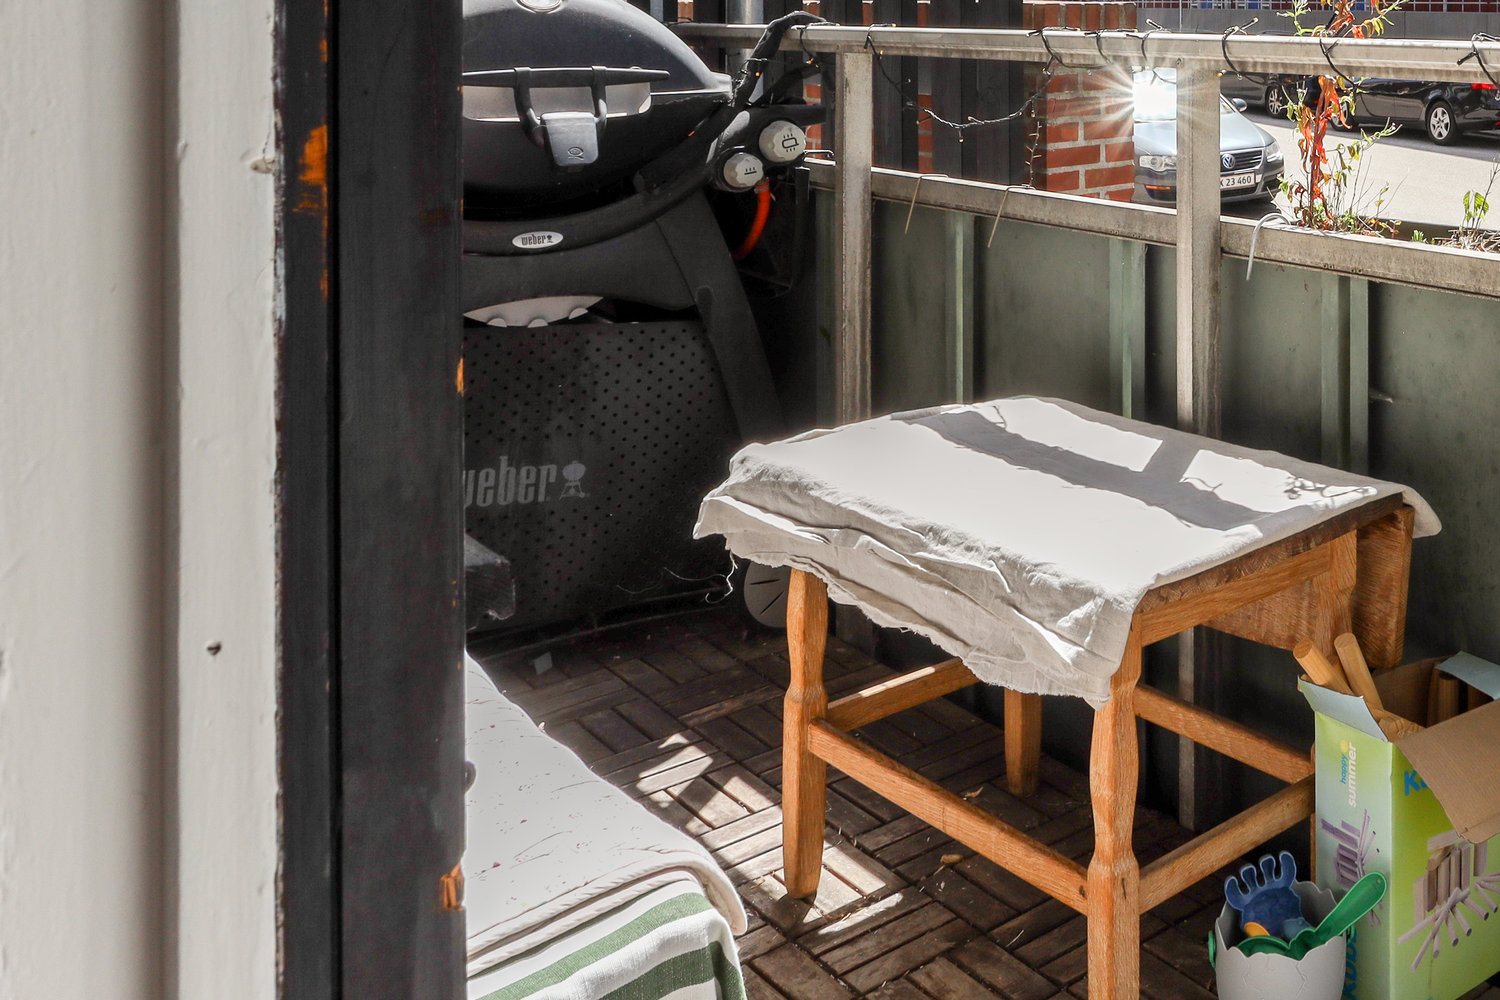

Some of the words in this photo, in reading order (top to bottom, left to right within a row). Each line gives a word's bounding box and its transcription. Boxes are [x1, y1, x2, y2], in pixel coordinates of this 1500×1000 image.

[1226, 178, 1236, 187] 23
[1237, 175, 1252, 185] 460
[521, 233, 546, 246] weber
[1339, 754, 1348, 784] happy
[1348, 741, 1357, 808] summer
